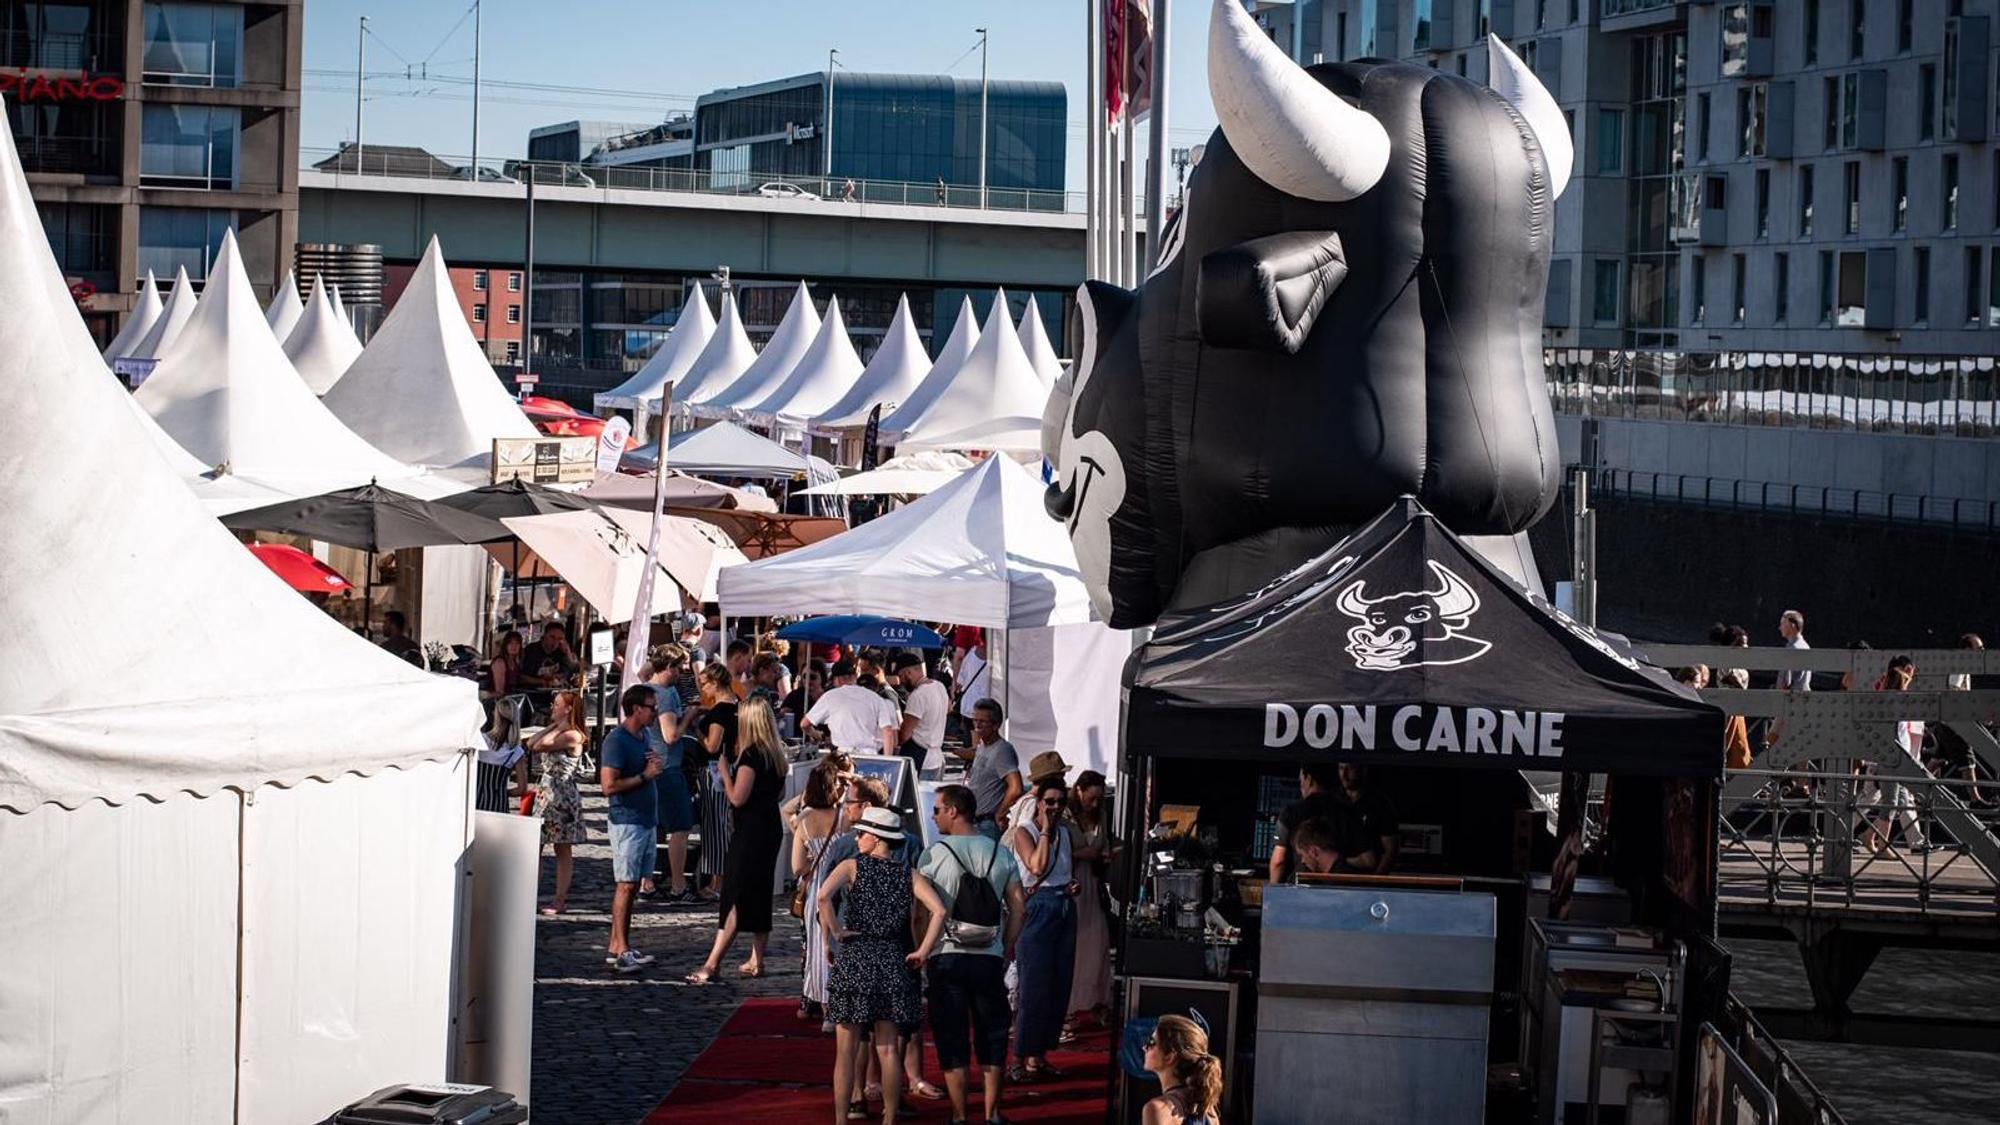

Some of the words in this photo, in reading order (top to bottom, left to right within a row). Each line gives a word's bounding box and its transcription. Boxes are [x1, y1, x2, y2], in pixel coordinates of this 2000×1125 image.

[881, 627, 913, 638] GROM
[1263, 703, 1377, 750] DON
[1392, 705, 1566, 757] CARNE
